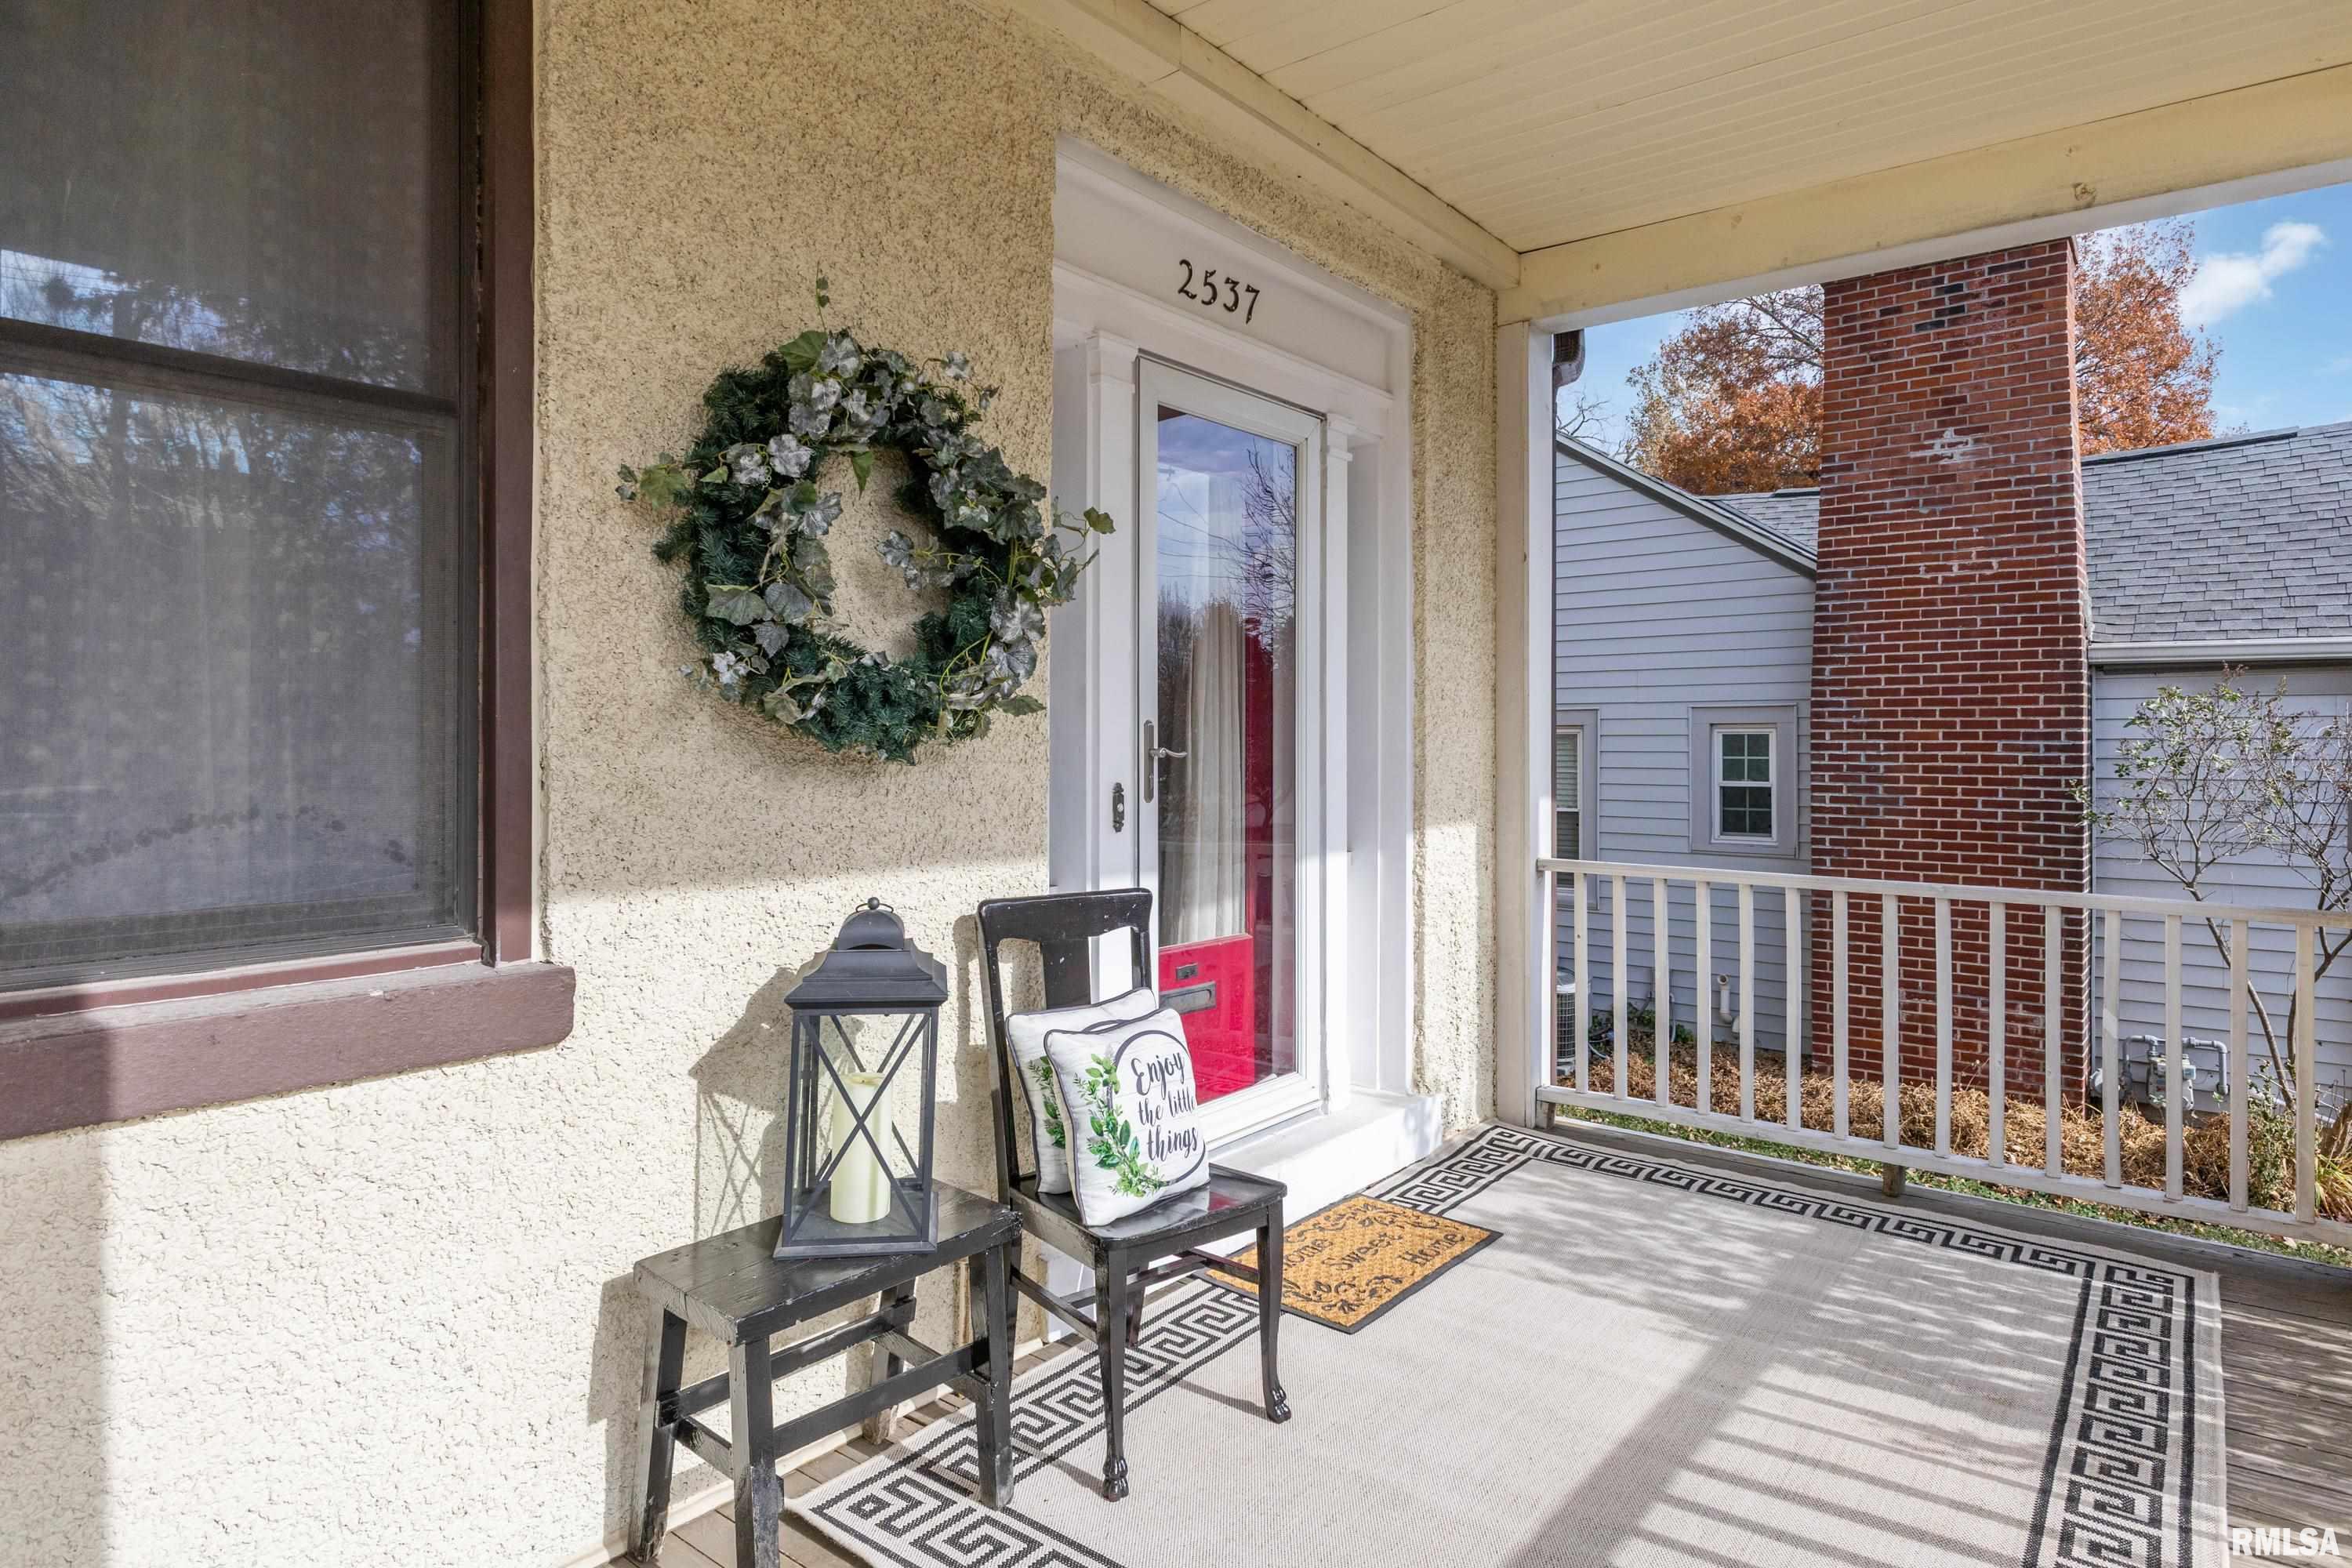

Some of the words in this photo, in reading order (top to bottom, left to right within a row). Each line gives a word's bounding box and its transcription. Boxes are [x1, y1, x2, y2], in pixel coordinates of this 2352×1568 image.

[1178, 259, 1260, 324] 2537
[1131, 1052, 1185, 1100] Enjoy
[1139, 1098, 1163, 1127] the
[1147, 1124, 1198, 1162] things
[1283, 1238, 1334, 1268] ome
[1320, 1232, 1403, 1271] Sweet
[1396, 1232, 1465, 1268] Home
